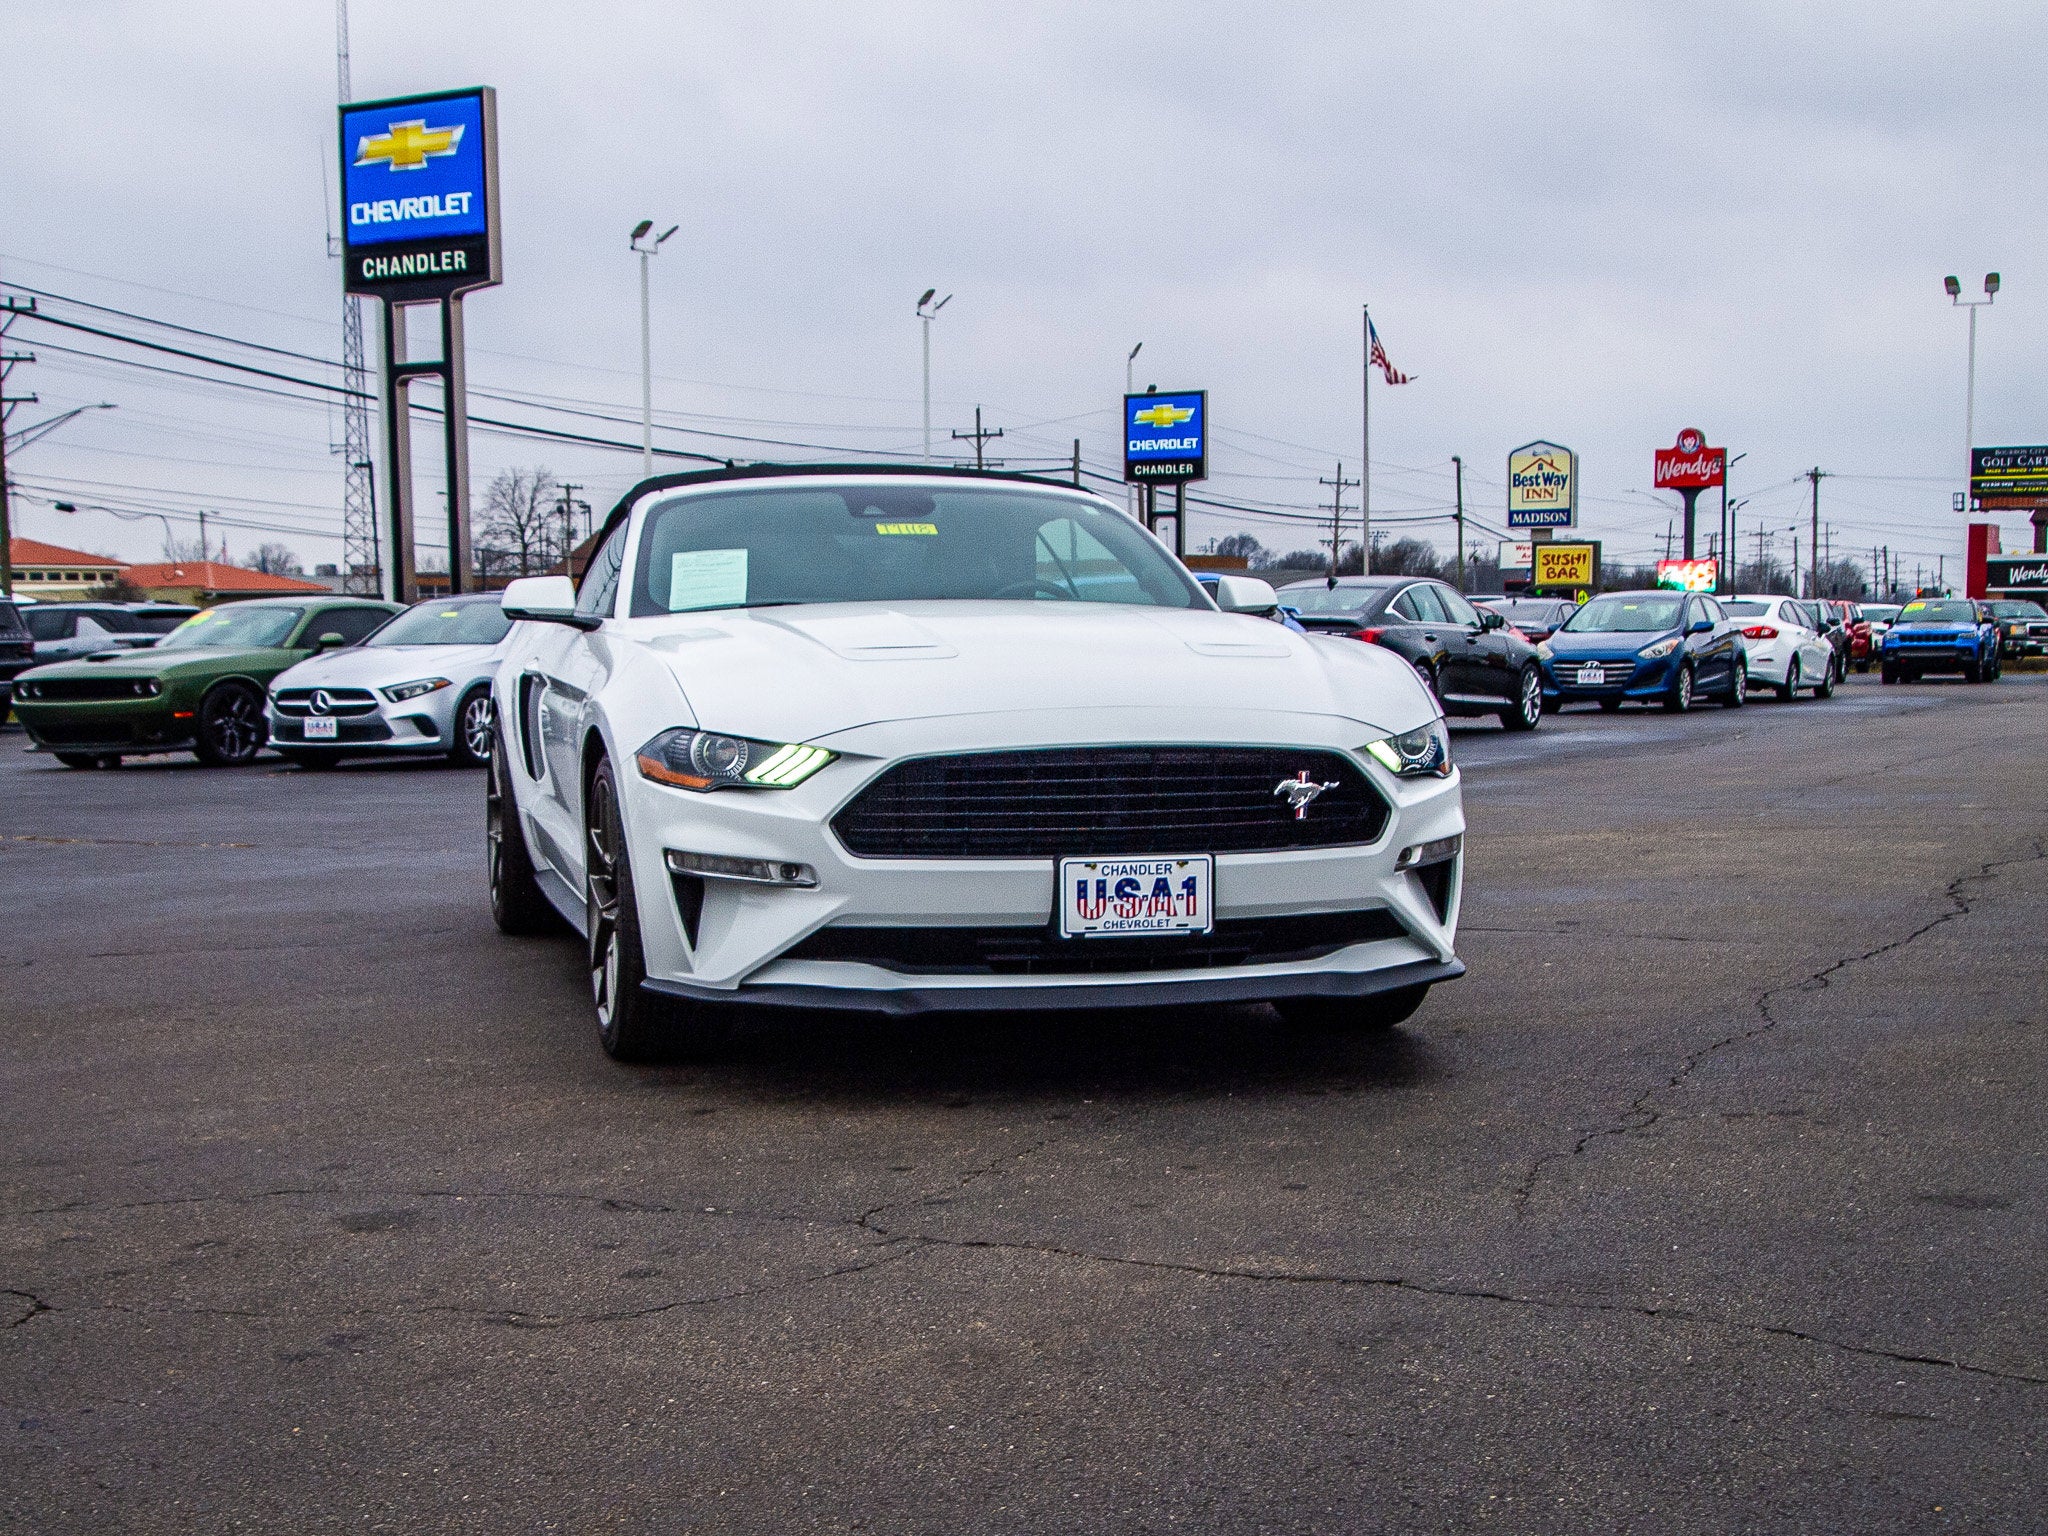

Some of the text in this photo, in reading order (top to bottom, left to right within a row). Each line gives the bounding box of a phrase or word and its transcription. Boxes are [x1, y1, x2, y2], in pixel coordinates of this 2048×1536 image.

[350, 191, 473, 226] CHEVROLET
[362, 249, 468, 279] CHANDLER
[1129, 437, 1199, 452] CHEVROLET
[1981, 456, 2014, 467] GOLF
[1134, 463, 1194, 476] CHANDLER
[1512, 471, 1568, 490] Best Way
[1525, 488, 1554, 499] INN
[1512, 511, 1568, 524] MADISON
[1541, 553, 1588, 567] SUSHI
[1546, 567, 1581, 580] BAR
[1101, 863, 1173, 877] CHANDLER
[1103, 918, 1171, 930] CHEVROLET
